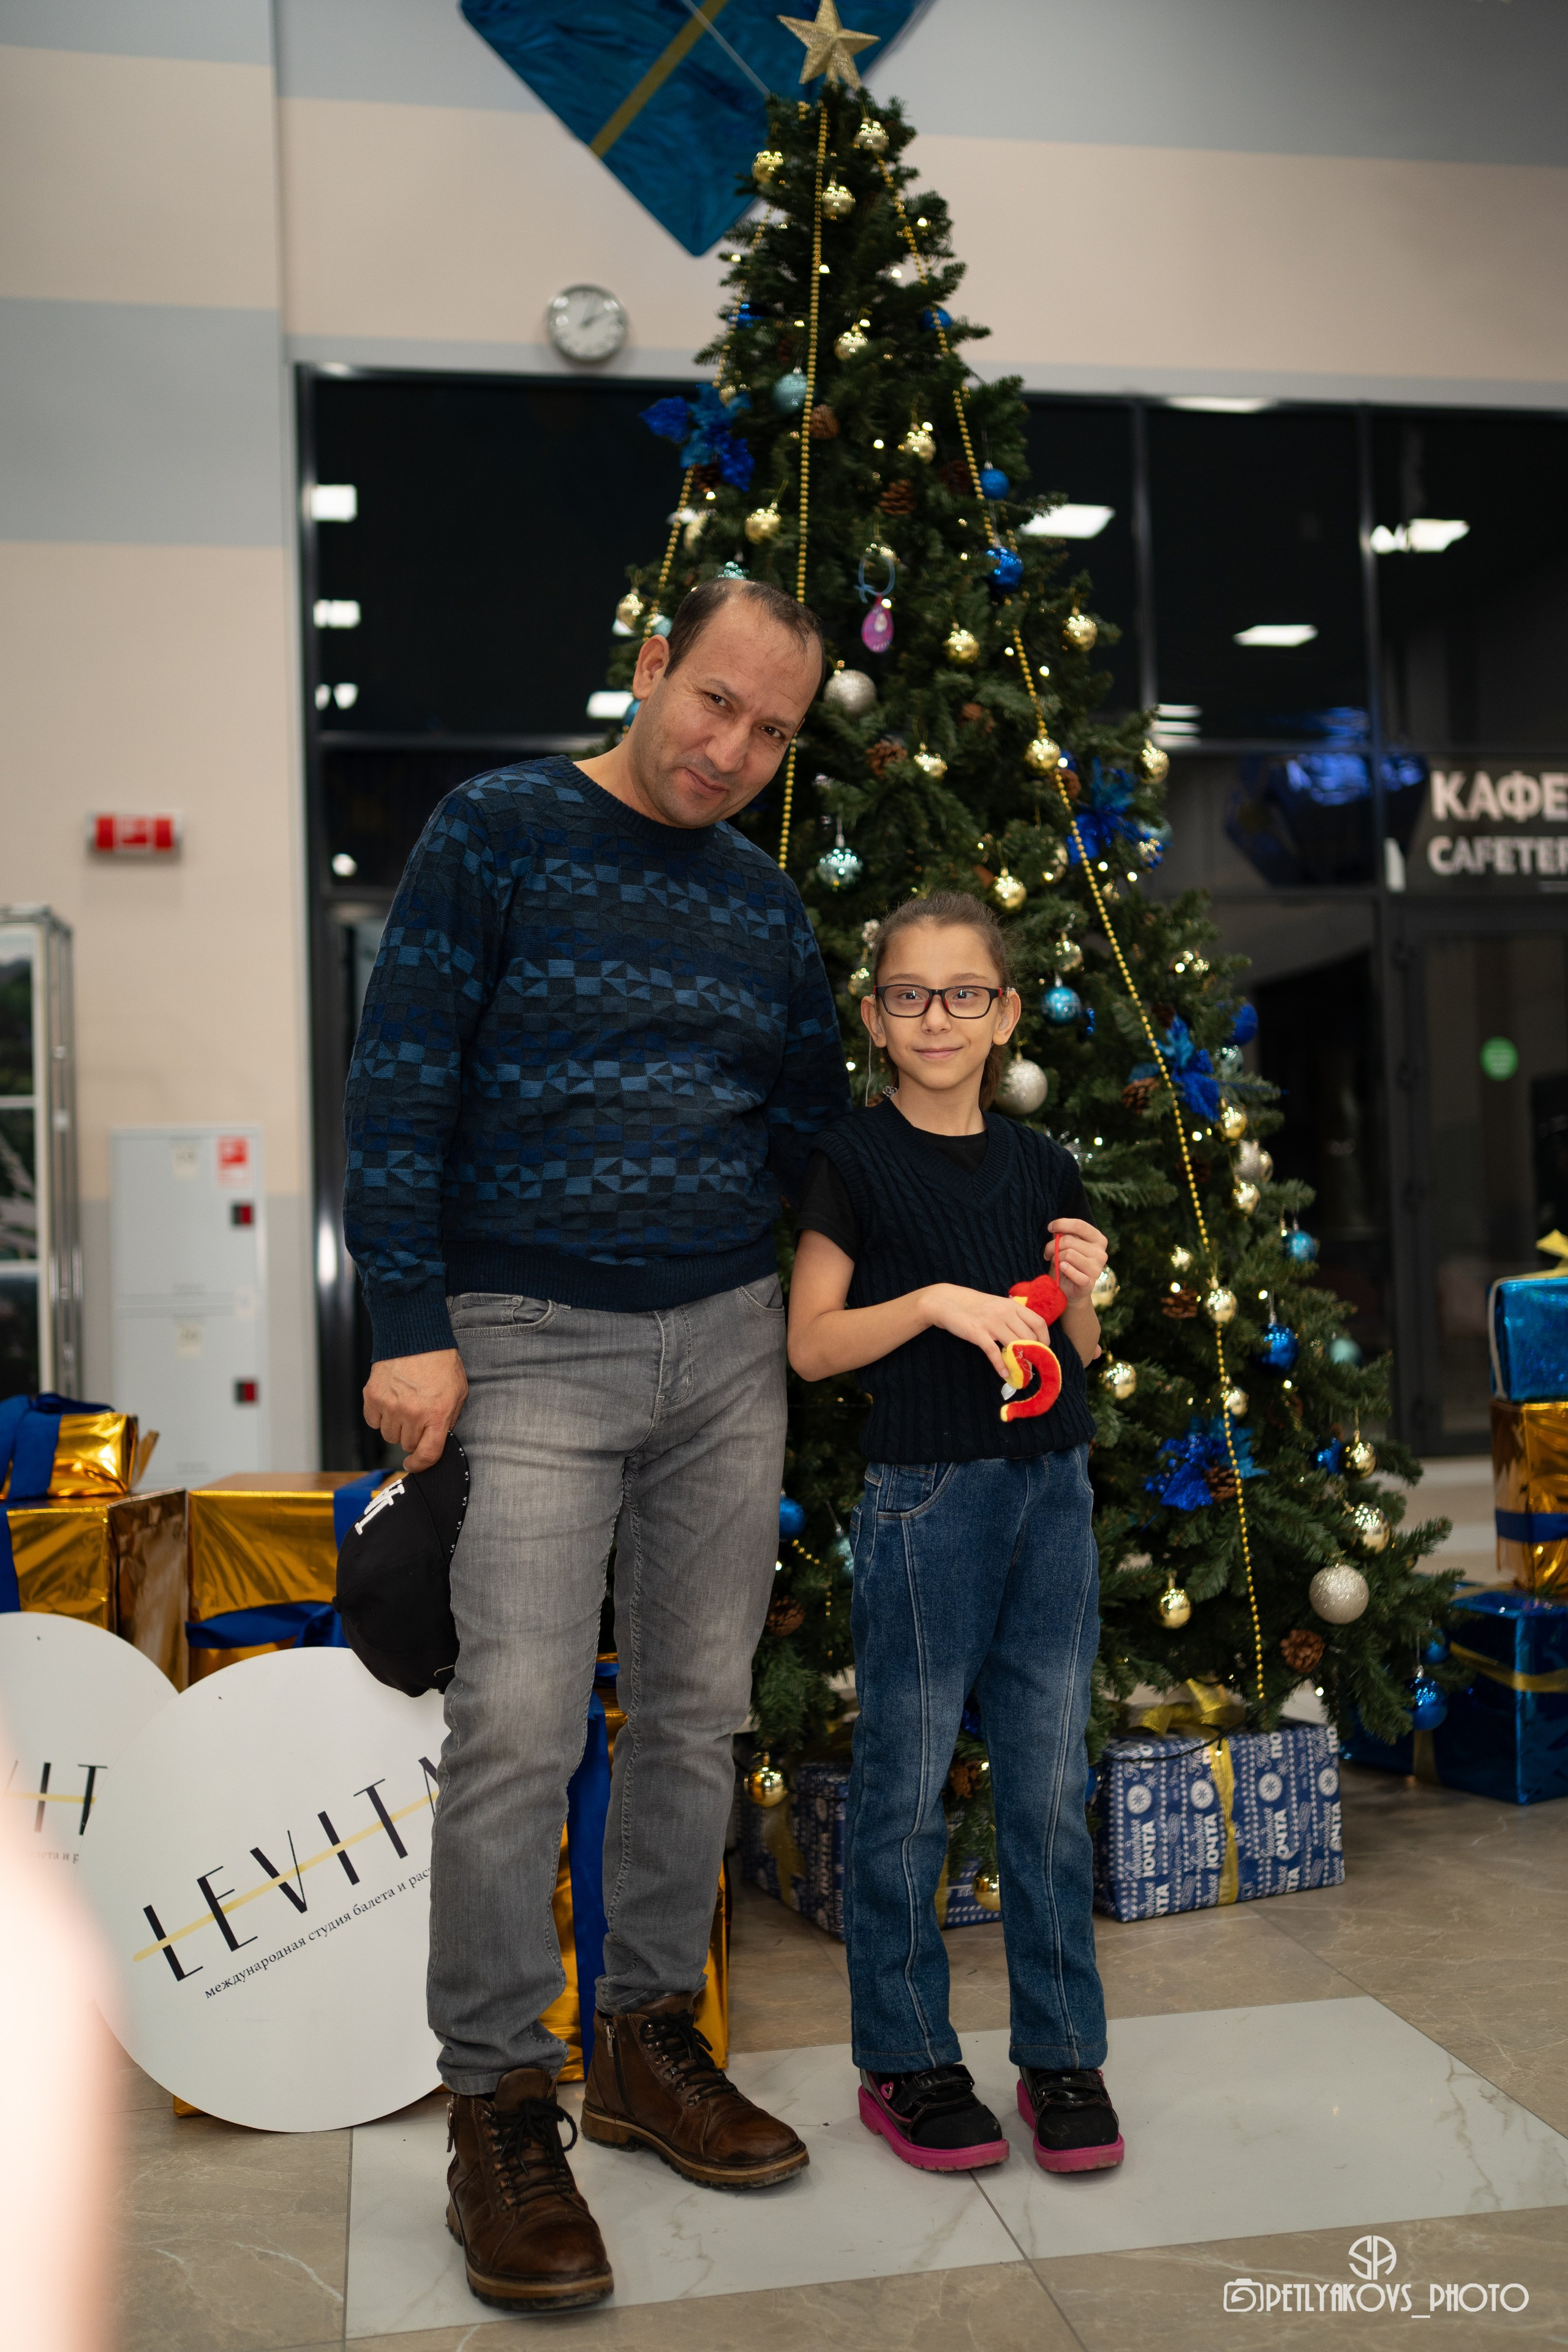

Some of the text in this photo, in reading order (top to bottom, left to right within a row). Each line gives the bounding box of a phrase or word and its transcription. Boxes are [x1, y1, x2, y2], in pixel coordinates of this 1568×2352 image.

[464, 1471, 470, 1480] LA
[1269, 1732, 1283, 1759] ПО
[204, 1937, 306, 1999] международная
[308, 1912, 352, 1940] студия
[352, 1889, 395, 1916] балета
[397, 1883, 407, 1893] и
